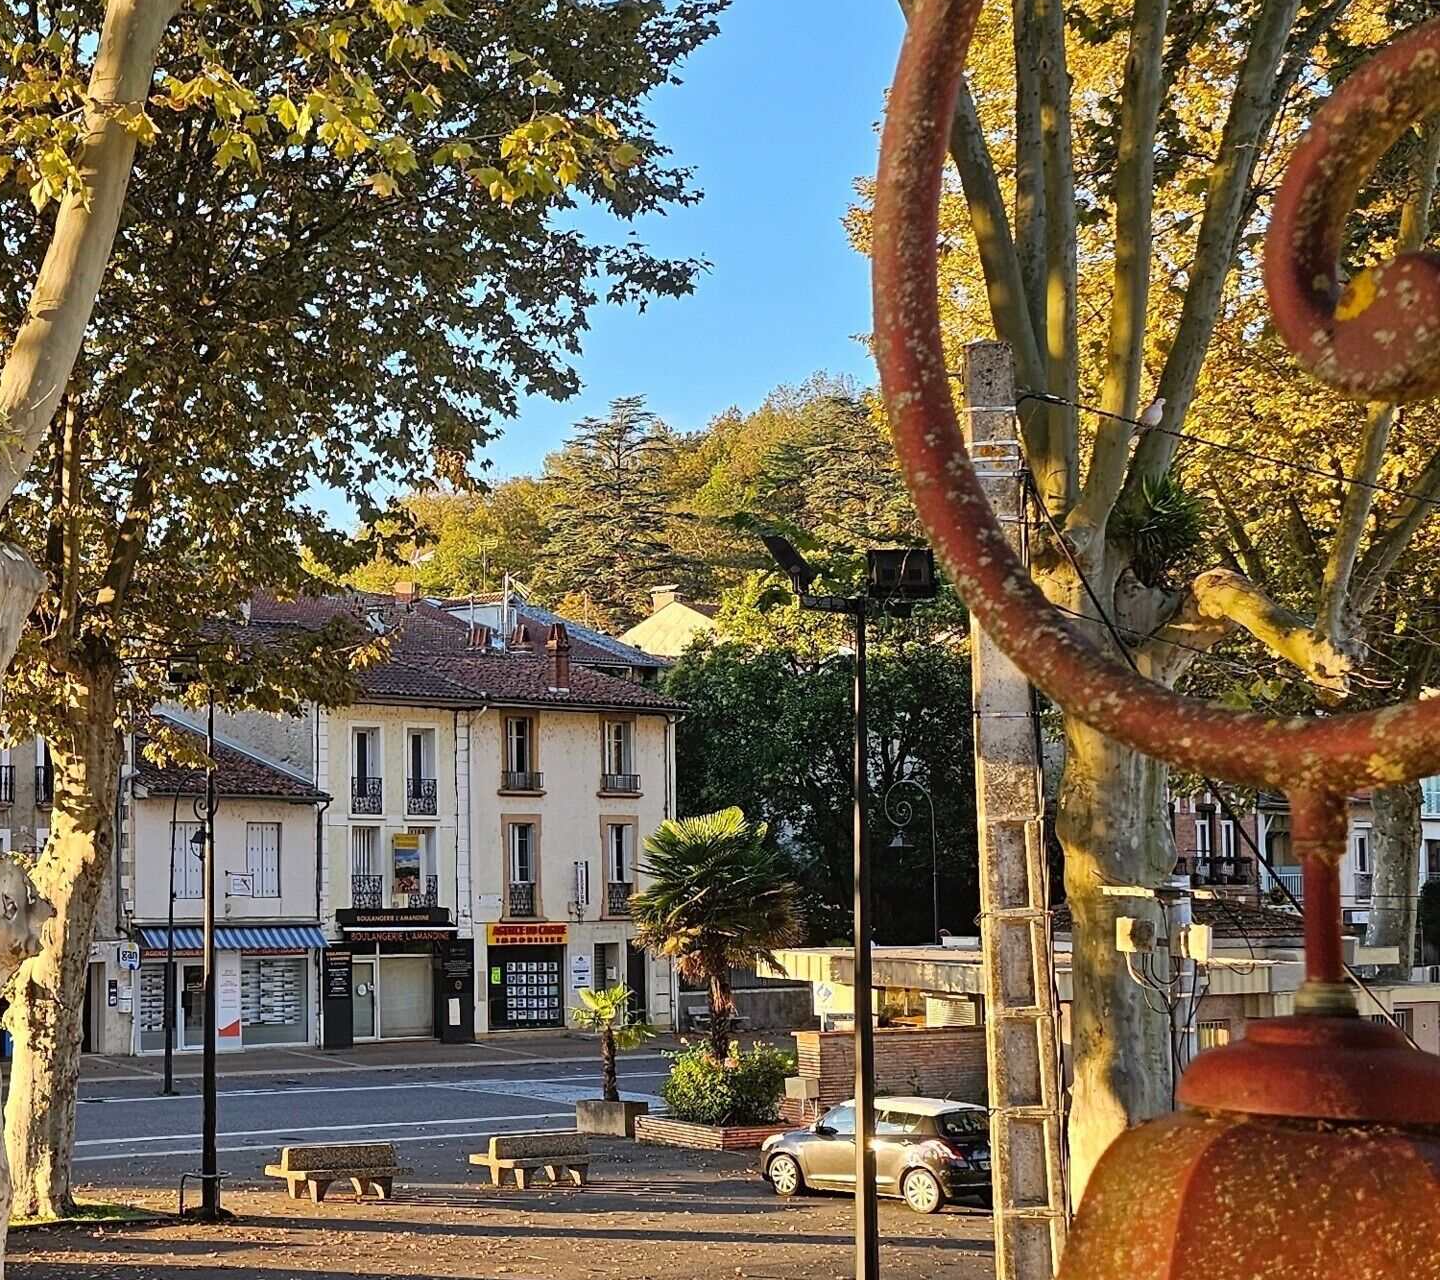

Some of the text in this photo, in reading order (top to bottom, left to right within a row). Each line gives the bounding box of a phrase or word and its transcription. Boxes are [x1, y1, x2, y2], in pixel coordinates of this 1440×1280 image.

[395, 914, 429, 922] L'AMANDINE
[351, 931, 450, 941] BOULANGERIE L'AMANDINE
[122, 951, 137, 961] gan
